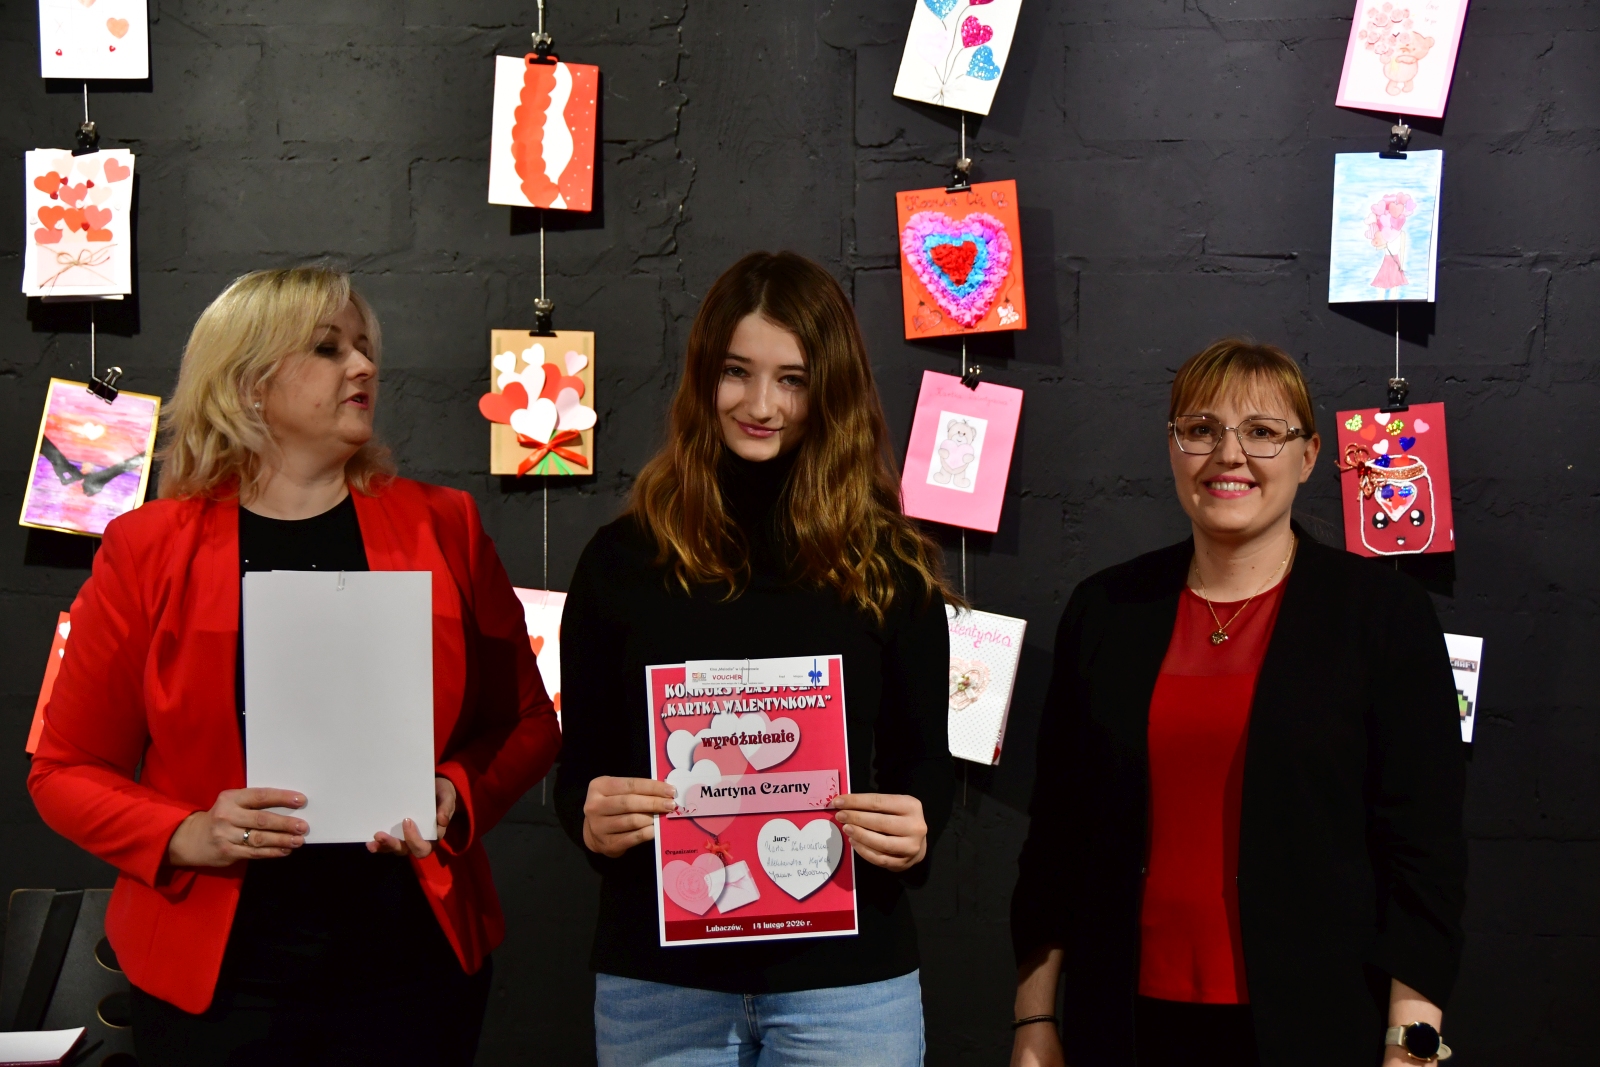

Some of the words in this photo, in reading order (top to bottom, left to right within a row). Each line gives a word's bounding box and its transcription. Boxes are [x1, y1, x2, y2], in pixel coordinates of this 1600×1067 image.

[701, 729, 795, 750] wyróżnienie
[700, 784, 756, 798] Martyna
[760, 782, 811, 794] Czarny
[706, 924, 744, 932] Lubaczów,
[763, 921, 784, 930] lutego
[786, 920, 806, 928] 2026
